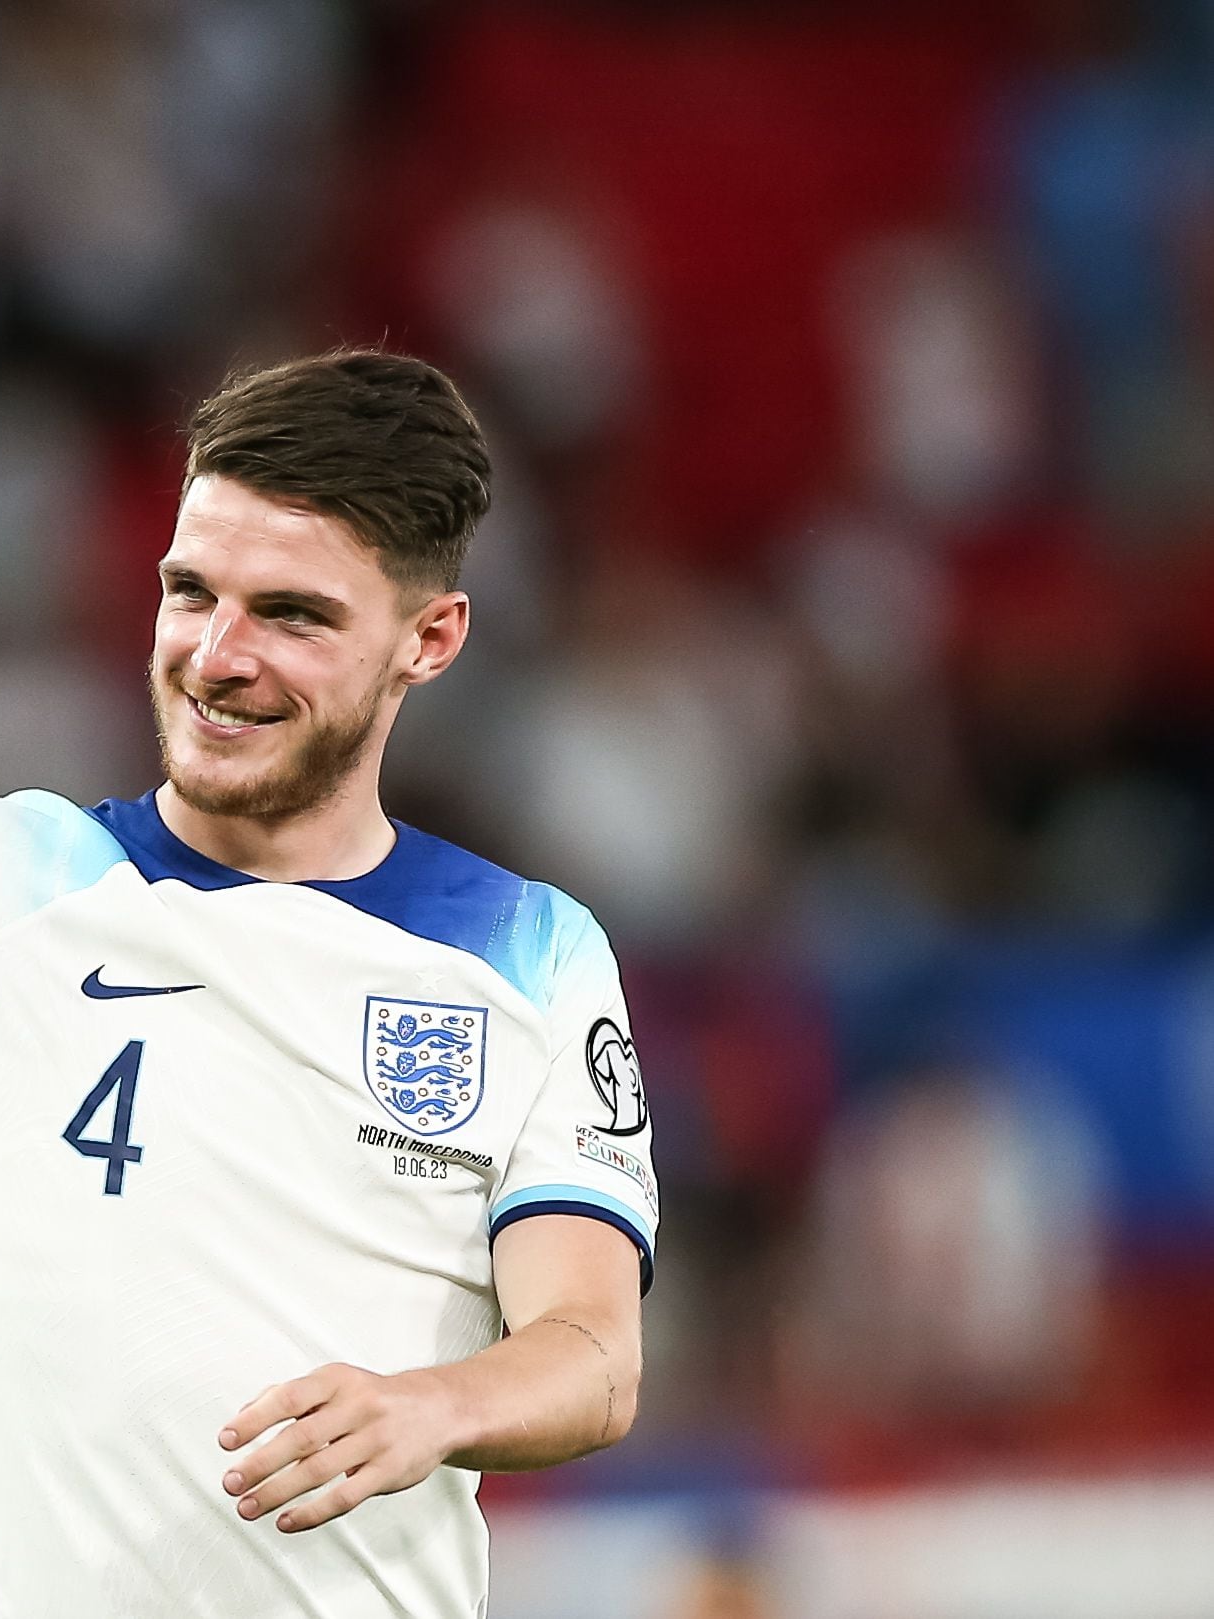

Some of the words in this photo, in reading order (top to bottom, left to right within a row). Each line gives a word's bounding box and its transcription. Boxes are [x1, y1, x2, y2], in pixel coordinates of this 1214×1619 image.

[61, 1038, 146, 1197] 4
[357, 1124, 407, 1149] NORTH
[576, 1125, 599, 1141] UEFA
[393, 1155, 448, 1179] 19.06.23
